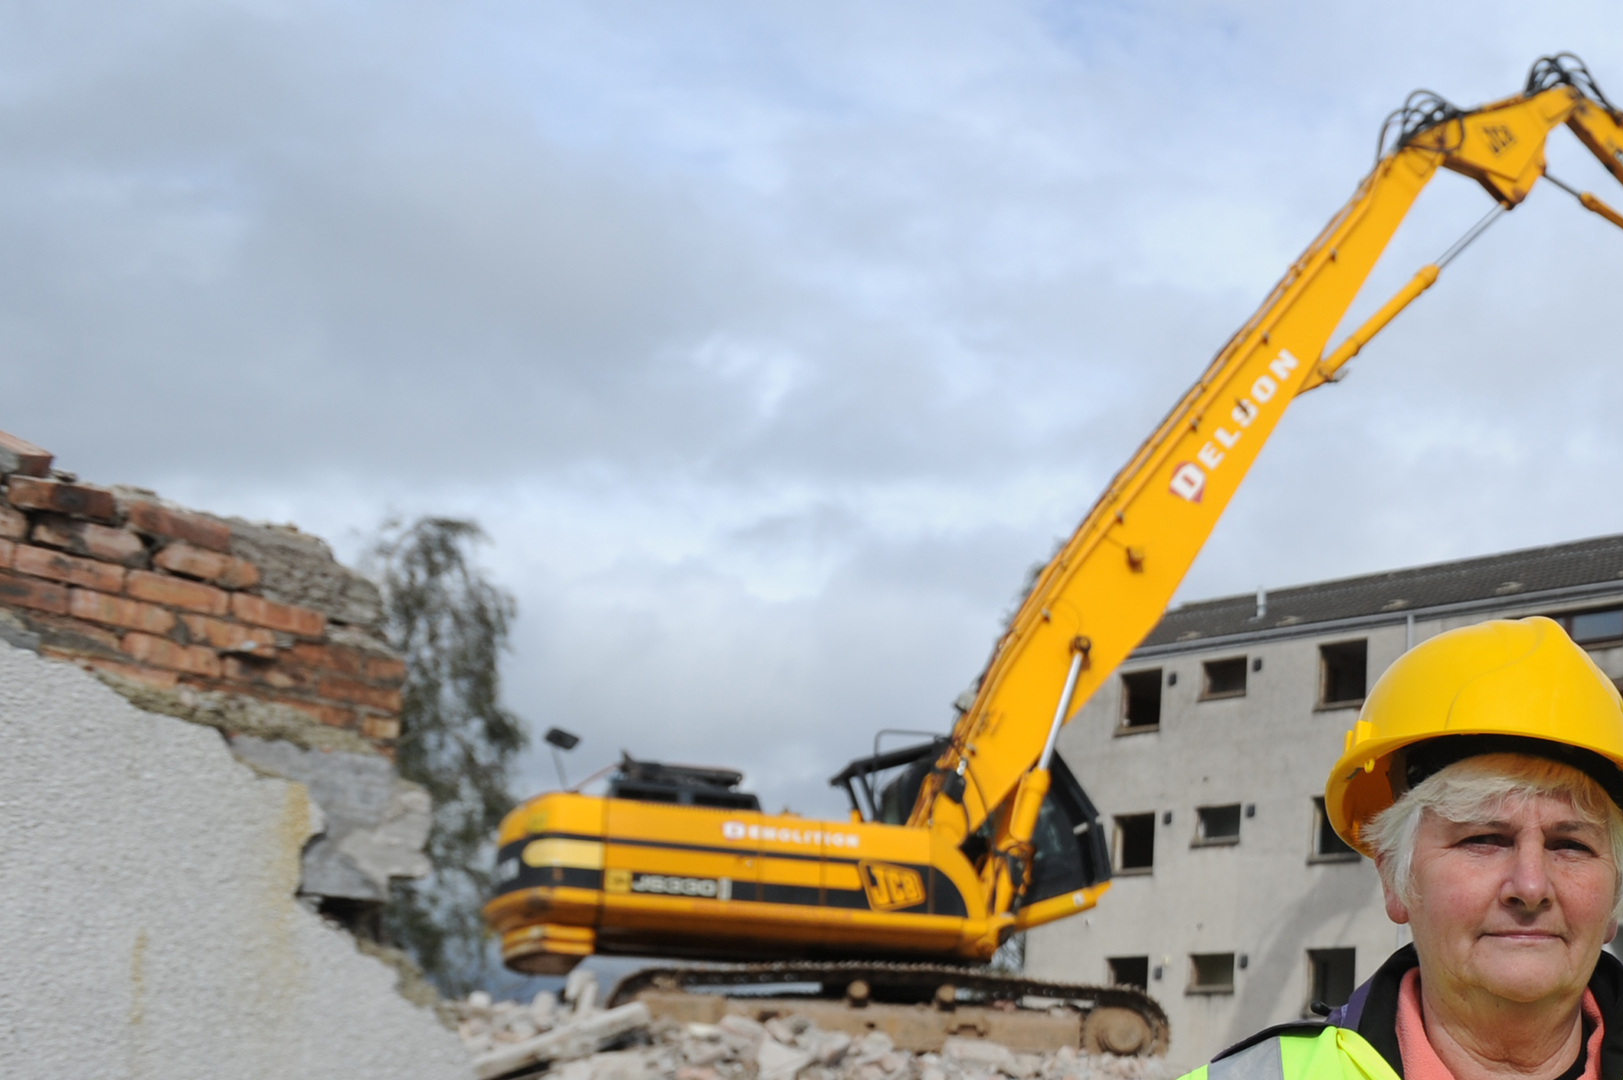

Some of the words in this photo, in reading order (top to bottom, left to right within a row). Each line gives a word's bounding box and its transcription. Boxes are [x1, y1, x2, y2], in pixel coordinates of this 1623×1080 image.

[1168, 348, 1300, 503] DELSON
[721, 819, 860, 849] DEMOLITION
[866, 863, 921, 906] JCB
